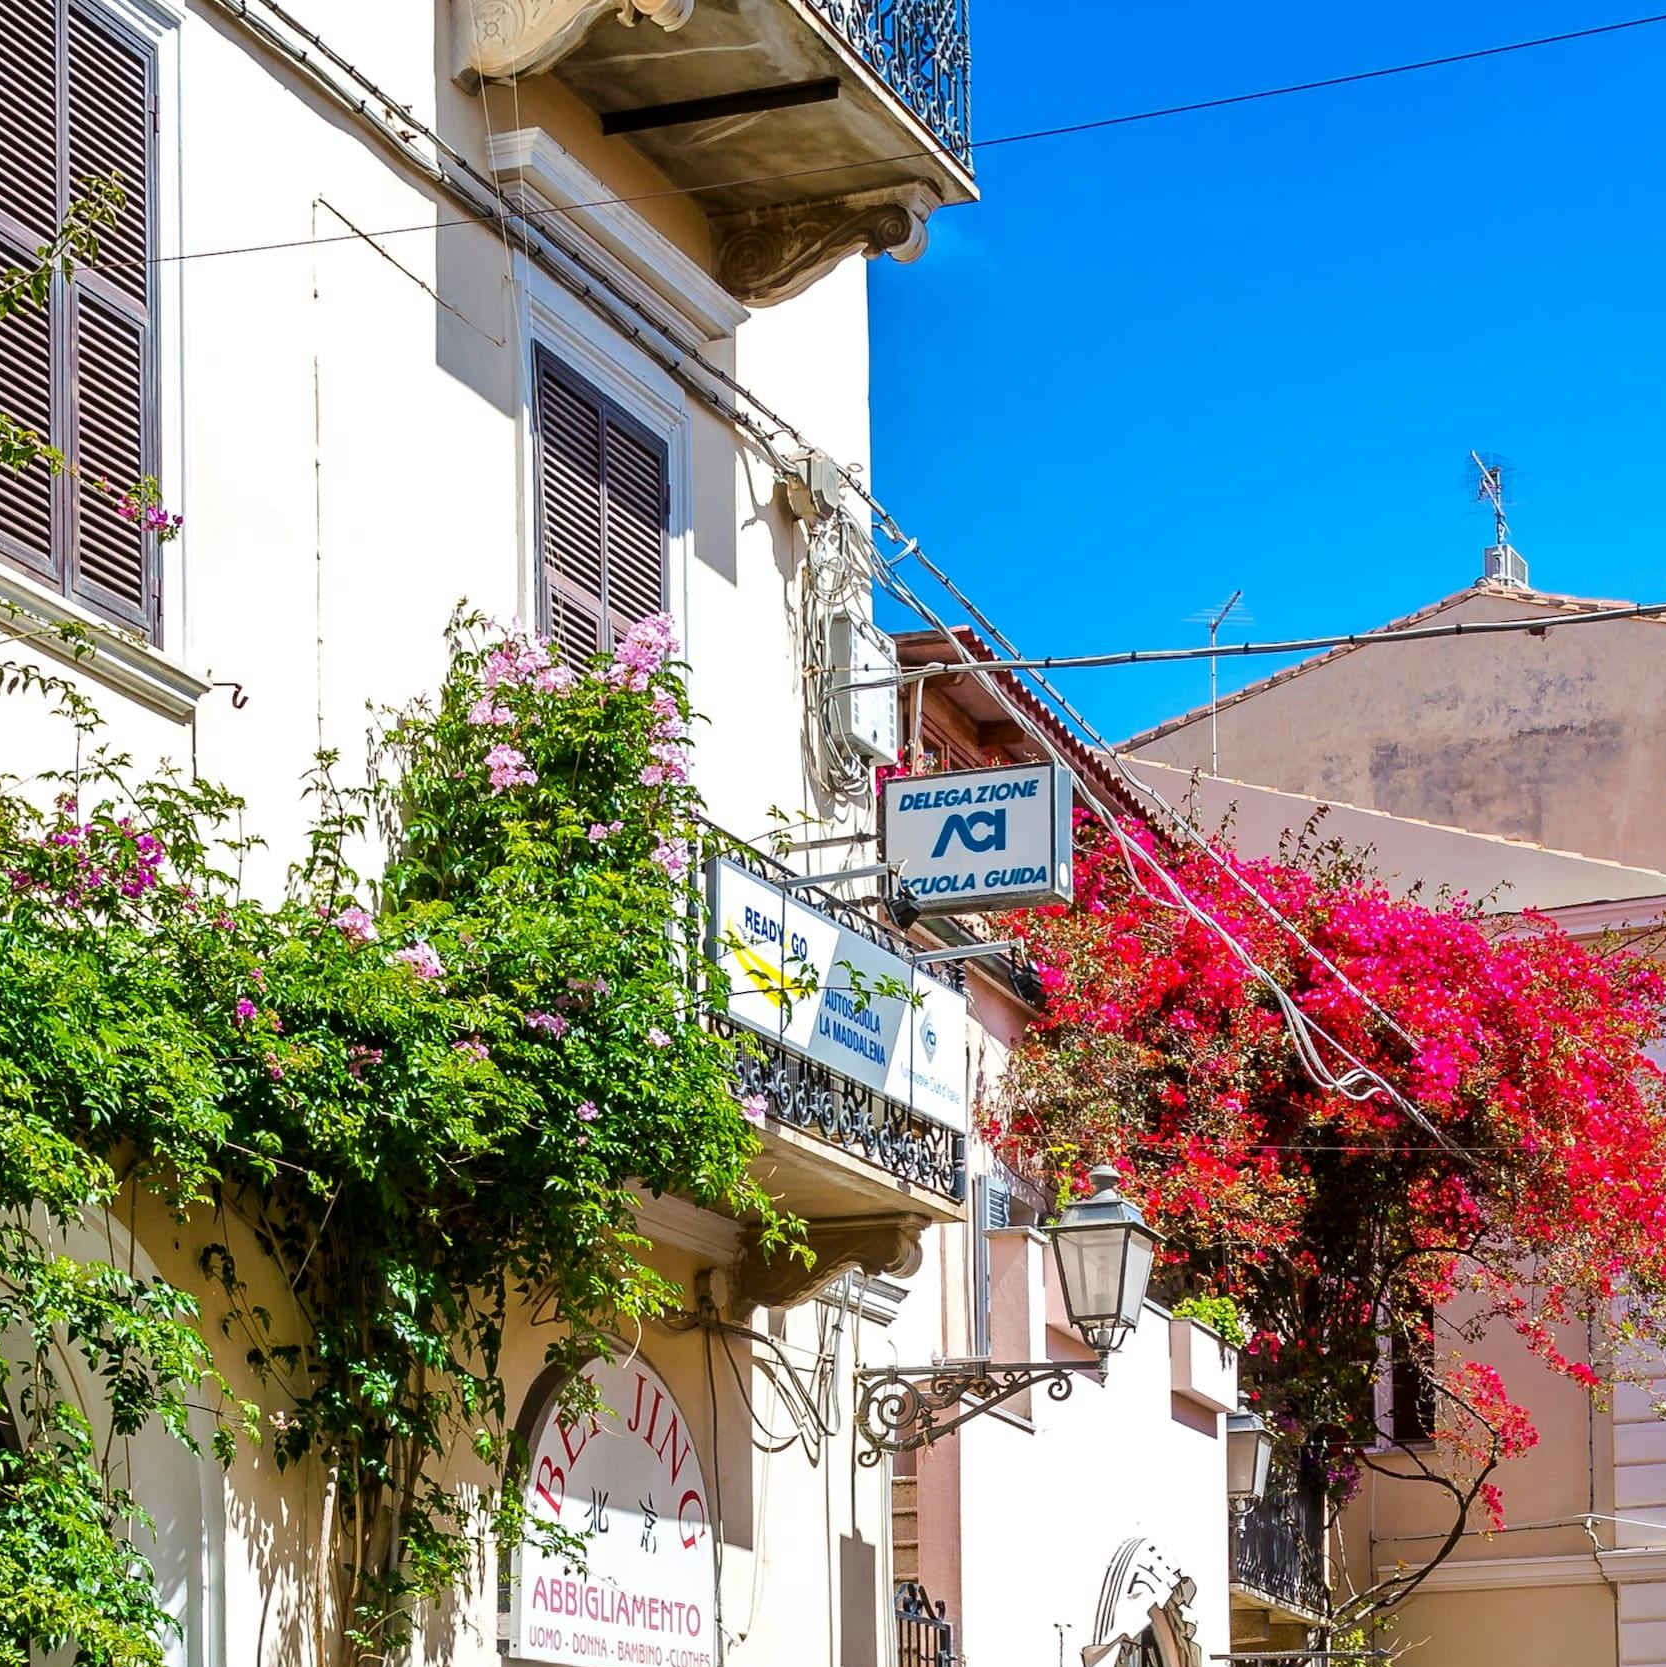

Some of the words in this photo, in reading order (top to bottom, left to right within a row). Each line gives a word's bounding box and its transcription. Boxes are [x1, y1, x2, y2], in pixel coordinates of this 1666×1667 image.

[898, 778, 1039, 812] DELEGAZIONE
[930, 808, 1007, 859] ACI
[984, 865, 1048, 889] GUIDA
[818, 1012, 831, 1039] LA
[832, 1020, 886, 1067] MADDALENA
[532, 1575, 701, 1637] ABBIGLIAMENTO
[529, 1624, 562, 1651] UOMO
[572, 1632, 608, 1659] DONNA
[617, 1640, 663, 1667] BAMBINO
